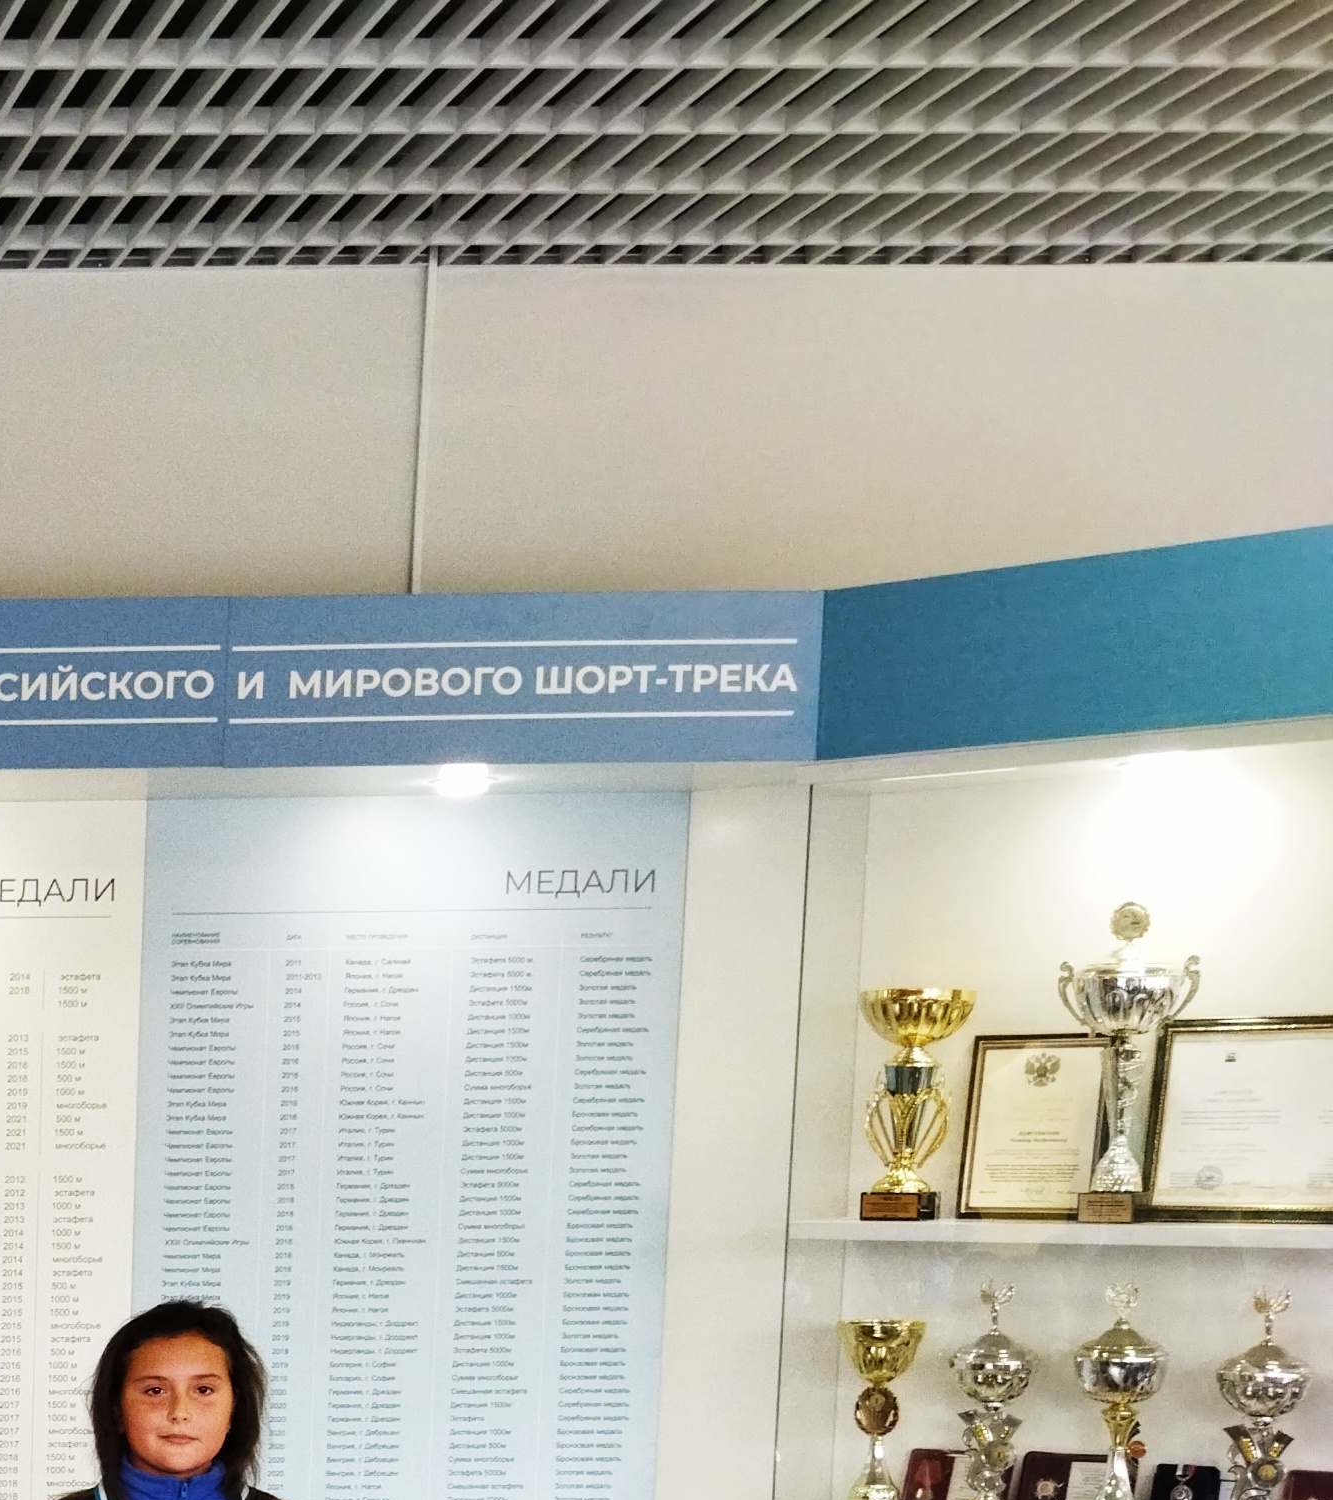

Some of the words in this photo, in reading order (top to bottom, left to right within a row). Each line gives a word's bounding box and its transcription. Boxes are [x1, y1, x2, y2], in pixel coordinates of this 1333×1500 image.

[238, 671, 264, 699] И
[290, 666, 522, 698] МИРОВОГО
[536, 664, 797, 694] ШОРТ-ТРЕКА
[506, 868, 656, 898] МЕДАЛИ
